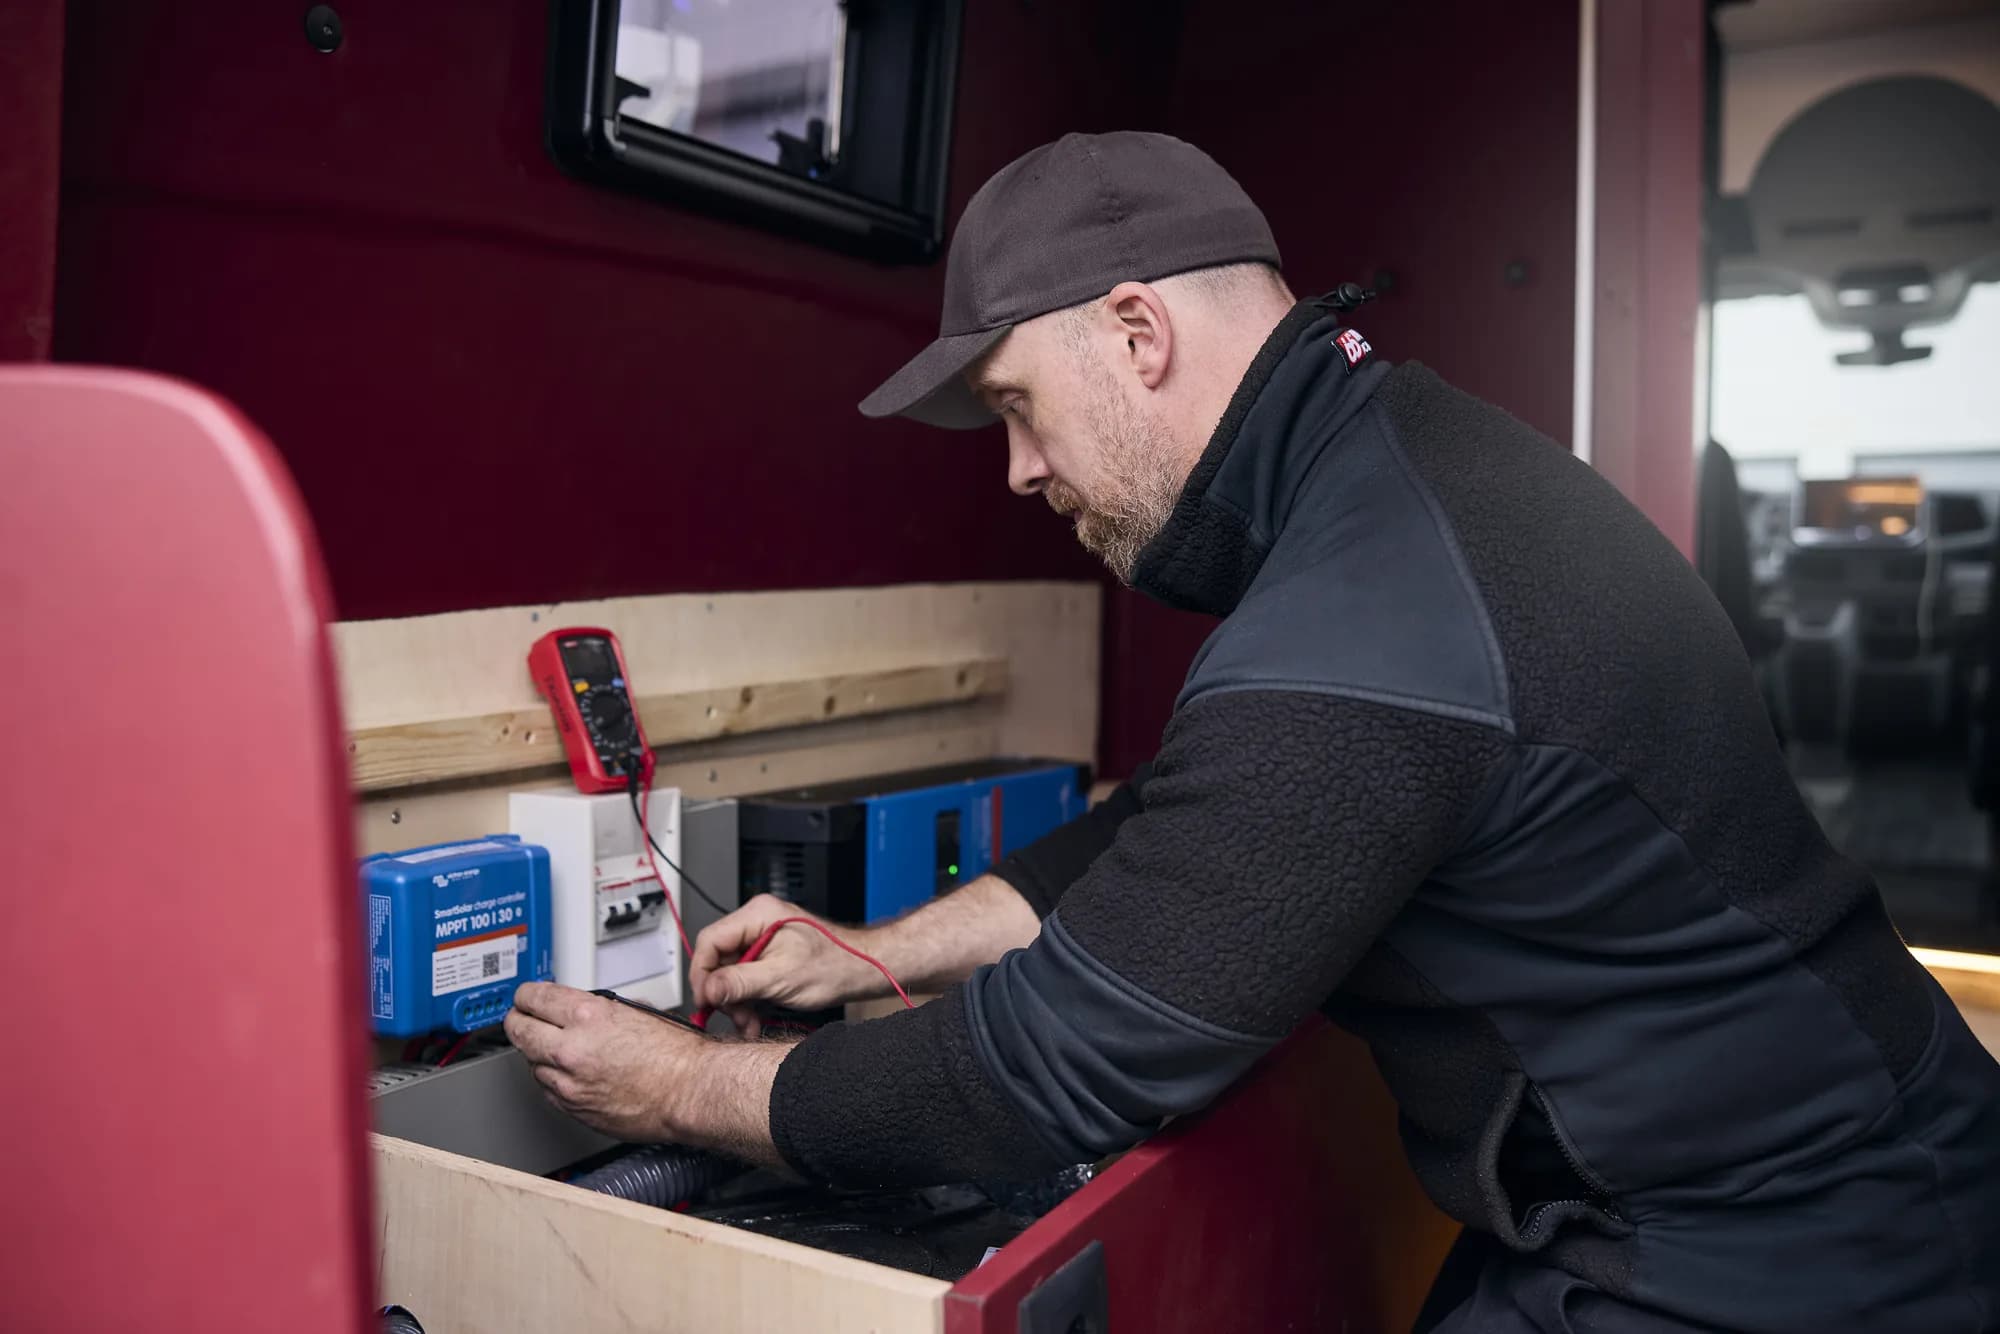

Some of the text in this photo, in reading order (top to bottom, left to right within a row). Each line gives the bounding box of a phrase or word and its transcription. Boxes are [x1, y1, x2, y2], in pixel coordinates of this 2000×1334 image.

[435, 917, 468, 938] MPPT
[470, 913, 490, 930] 100
[498, 907, 513, 923] 30
